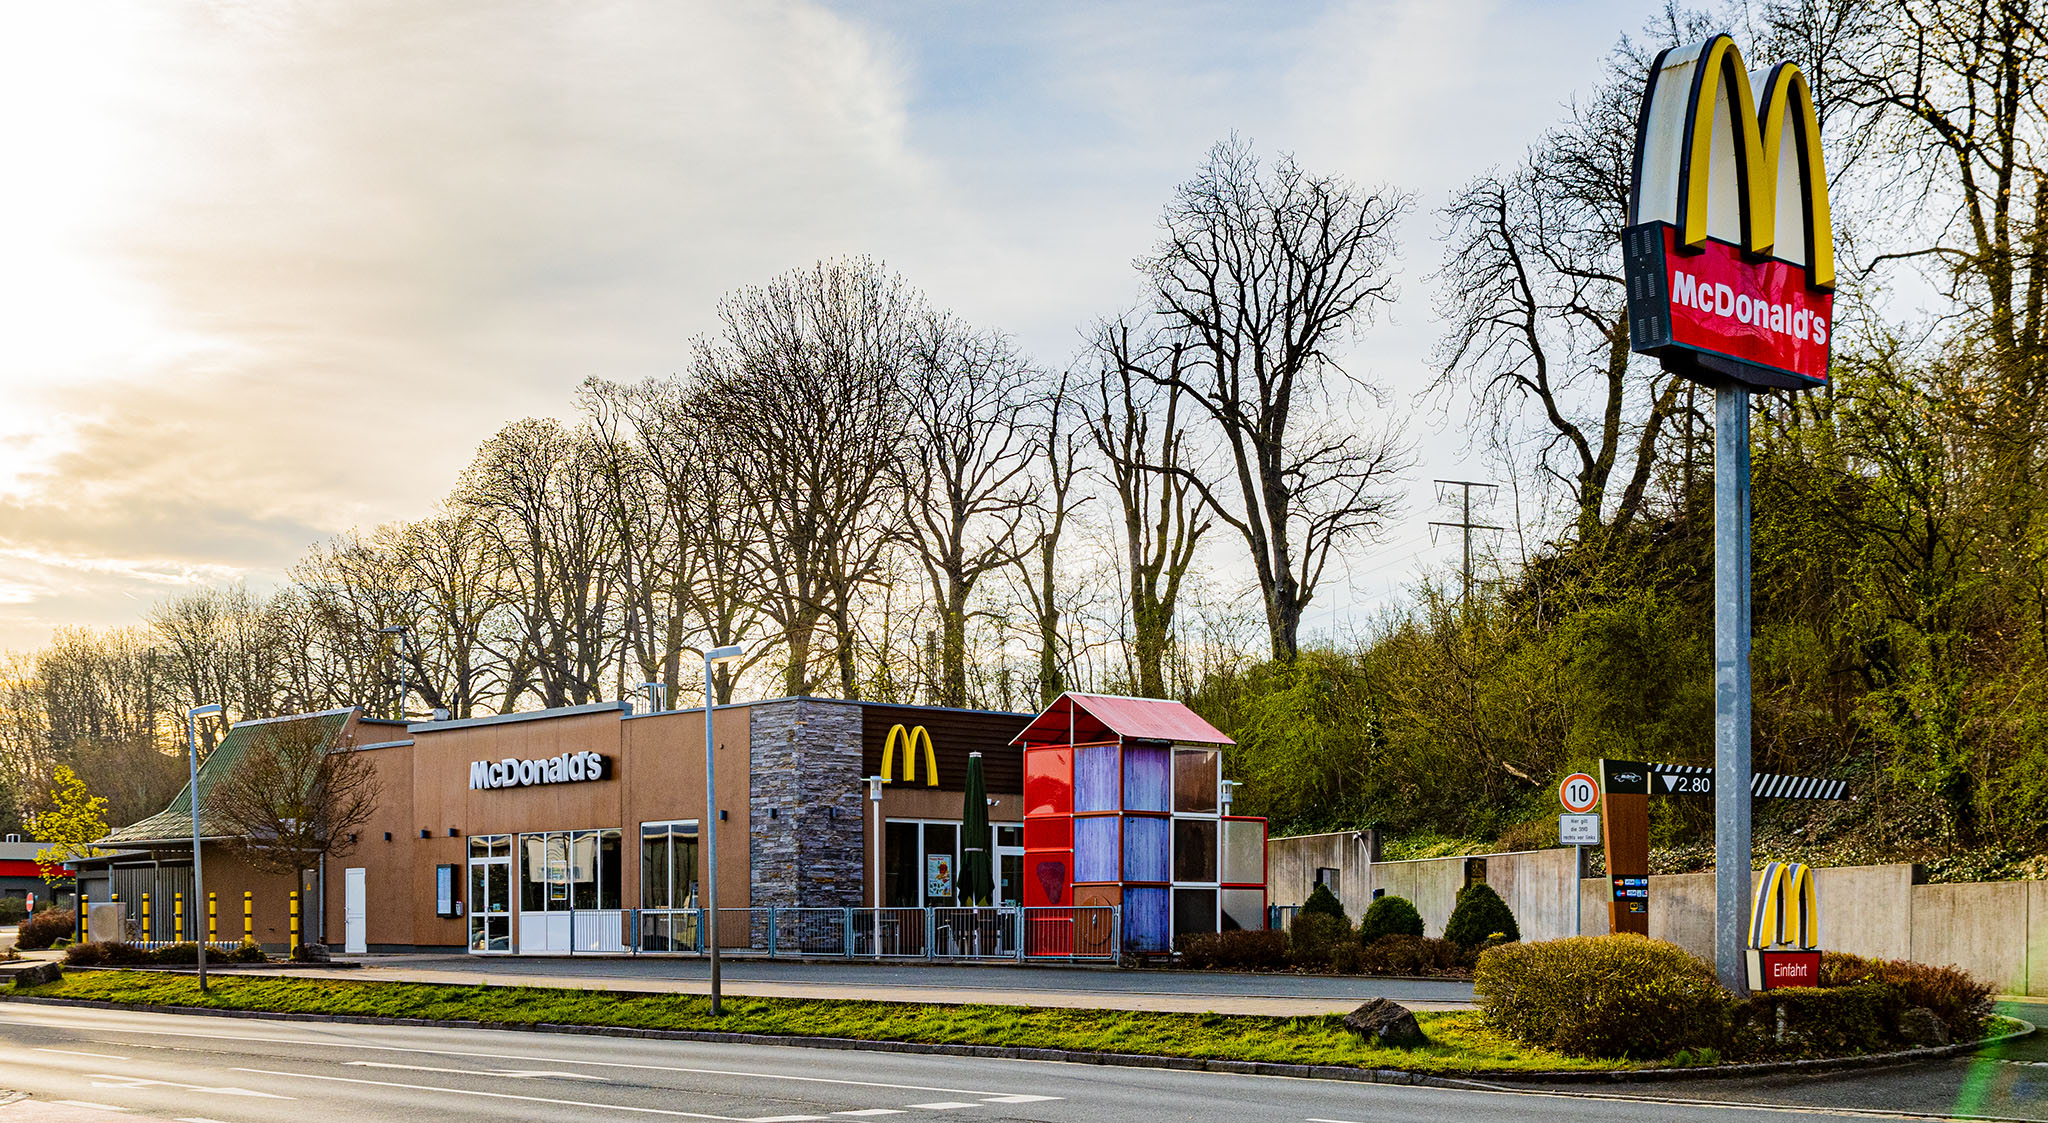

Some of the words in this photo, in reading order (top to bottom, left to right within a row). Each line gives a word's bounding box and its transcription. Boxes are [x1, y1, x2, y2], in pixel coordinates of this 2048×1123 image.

[1672, 270, 1827, 345] McDonald's
[469, 750, 603, 790] McDonald's
[1570, 784, 1589, 802] 10
[1678, 777, 1711, 793] 2.80
[1774, 962, 1808, 977] Einfahrt
